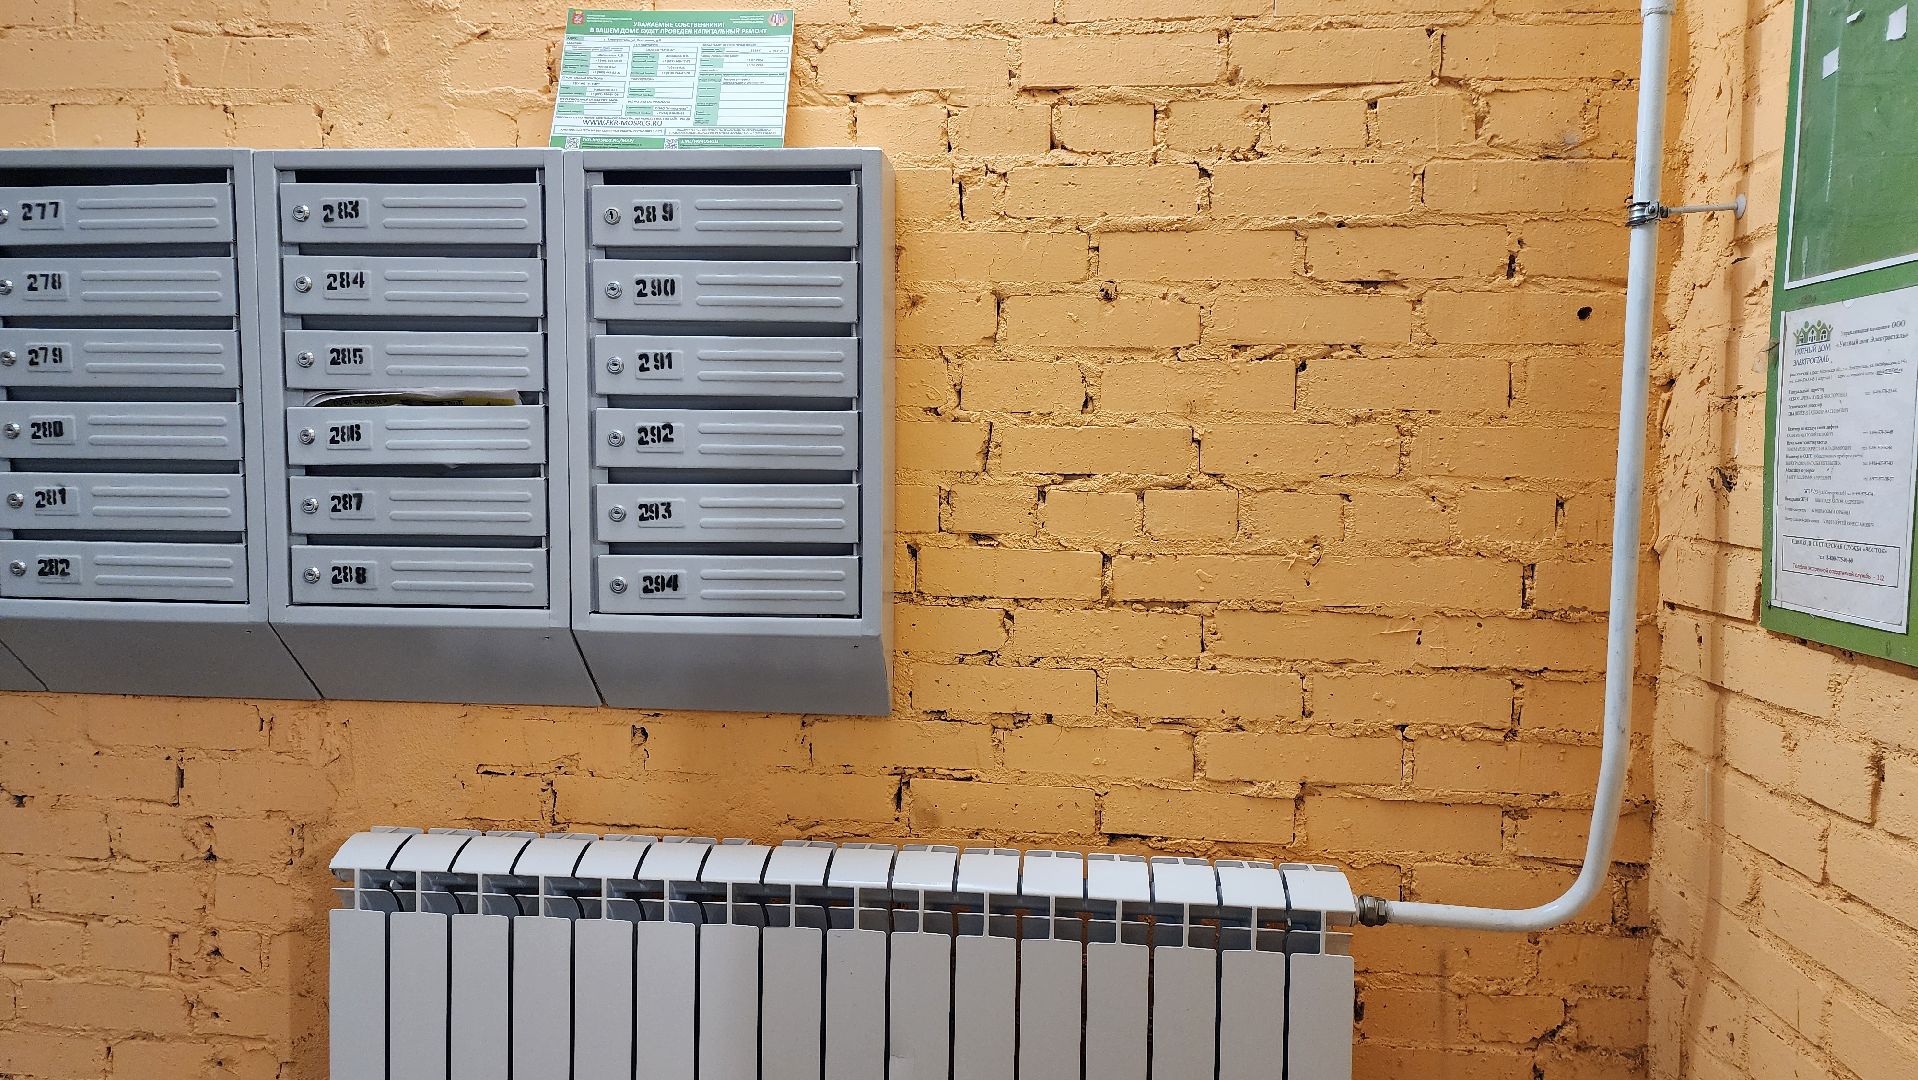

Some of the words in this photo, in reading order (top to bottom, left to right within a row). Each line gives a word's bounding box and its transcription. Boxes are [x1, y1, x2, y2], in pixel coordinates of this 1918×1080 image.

[22, 202, 59, 221] 277
[323, 201, 359, 222] 283
[634, 203, 673, 224] 289
[27, 274, 61, 291] 278
[327, 272, 364, 290] 284
[636, 279, 675, 297] 290
[28, 347, 62, 366] 279
[330, 348, 363, 366] 285
[638, 352, 672, 372] 291
[31, 421, 64, 439] 280
[330, 424, 361, 444] 286
[638, 424, 673, 445] 292
[35, 488, 66, 508] 281
[331, 493, 362, 512] 287
[638, 502, 671, 521] 293
[38, 559, 70, 577] 282
[332, 566, 366, 584] 288
[643, 574, 678, 593] 294
